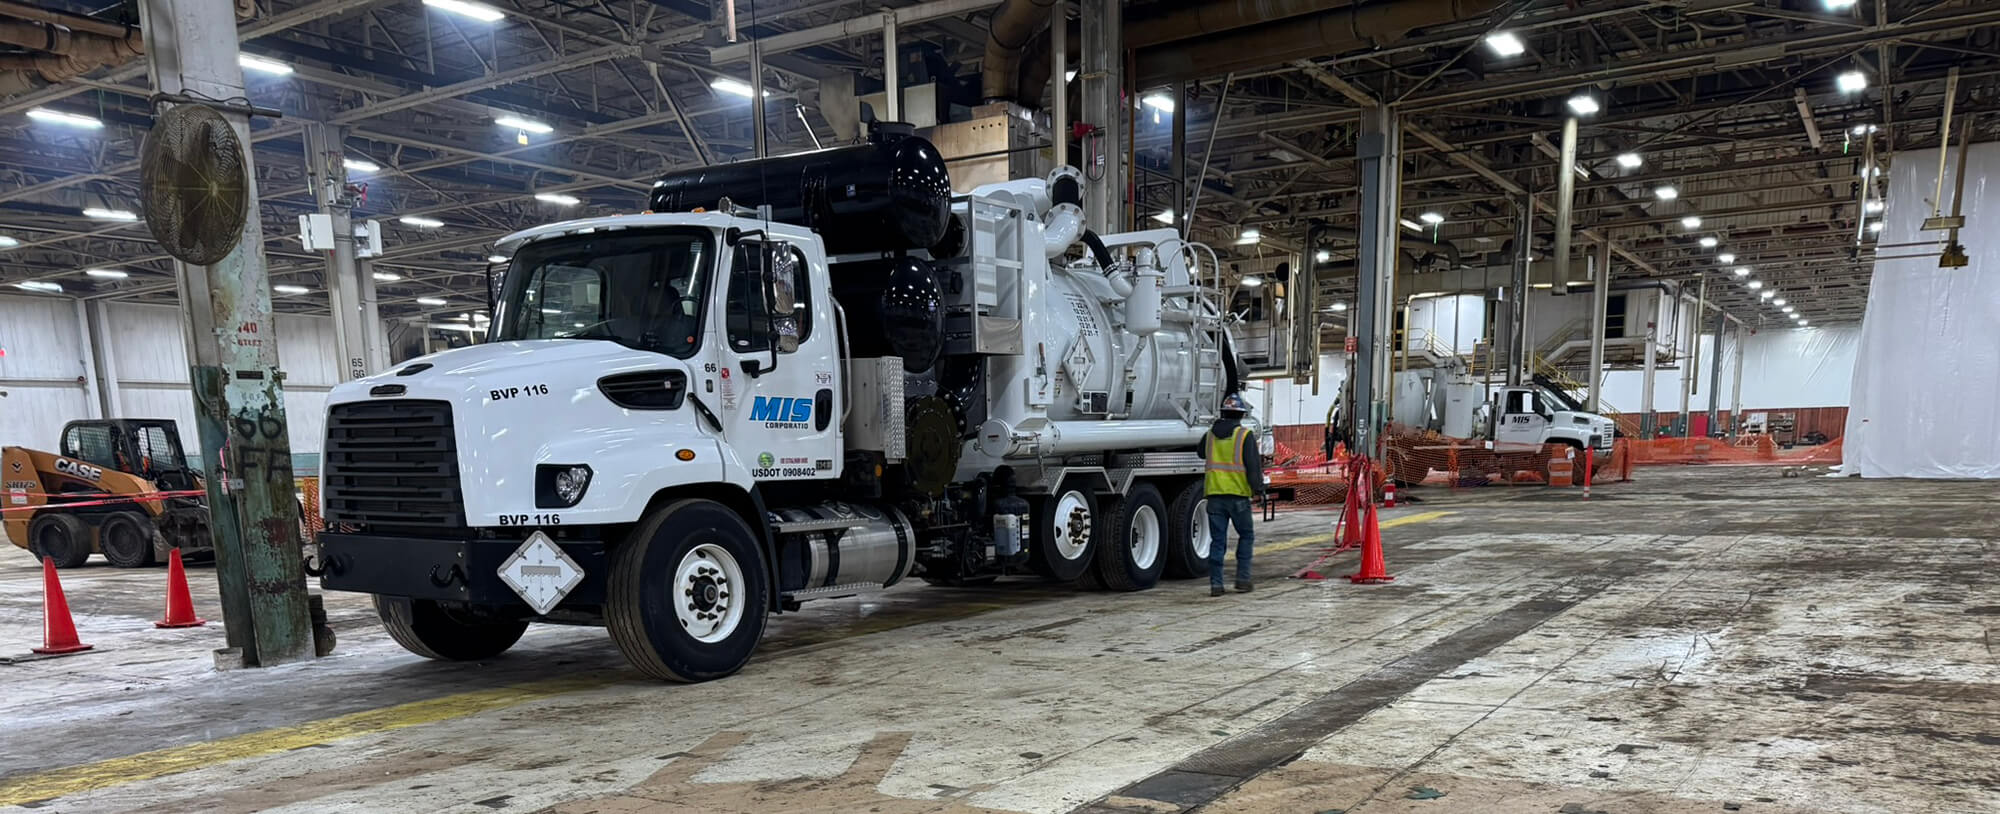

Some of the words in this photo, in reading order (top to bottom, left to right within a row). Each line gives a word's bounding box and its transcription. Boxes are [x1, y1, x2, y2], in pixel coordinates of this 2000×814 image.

[352, 358, 363, 367] 65
[705, 363, 716, 373] 66
[490, 387, 519, 401] BVP
[523, 384, 548, 397] 116
[749, 396, 812, 422] MIS
[1512, 416, 1530, 424] MIS
[55, 458, 102, 481] CASE
[752, 468, 781, 477] USDOT
[782, 467, 816, 477] 0908402
[499, 514, 529, 525] BVP
[534, 513, 560, 524] 116
